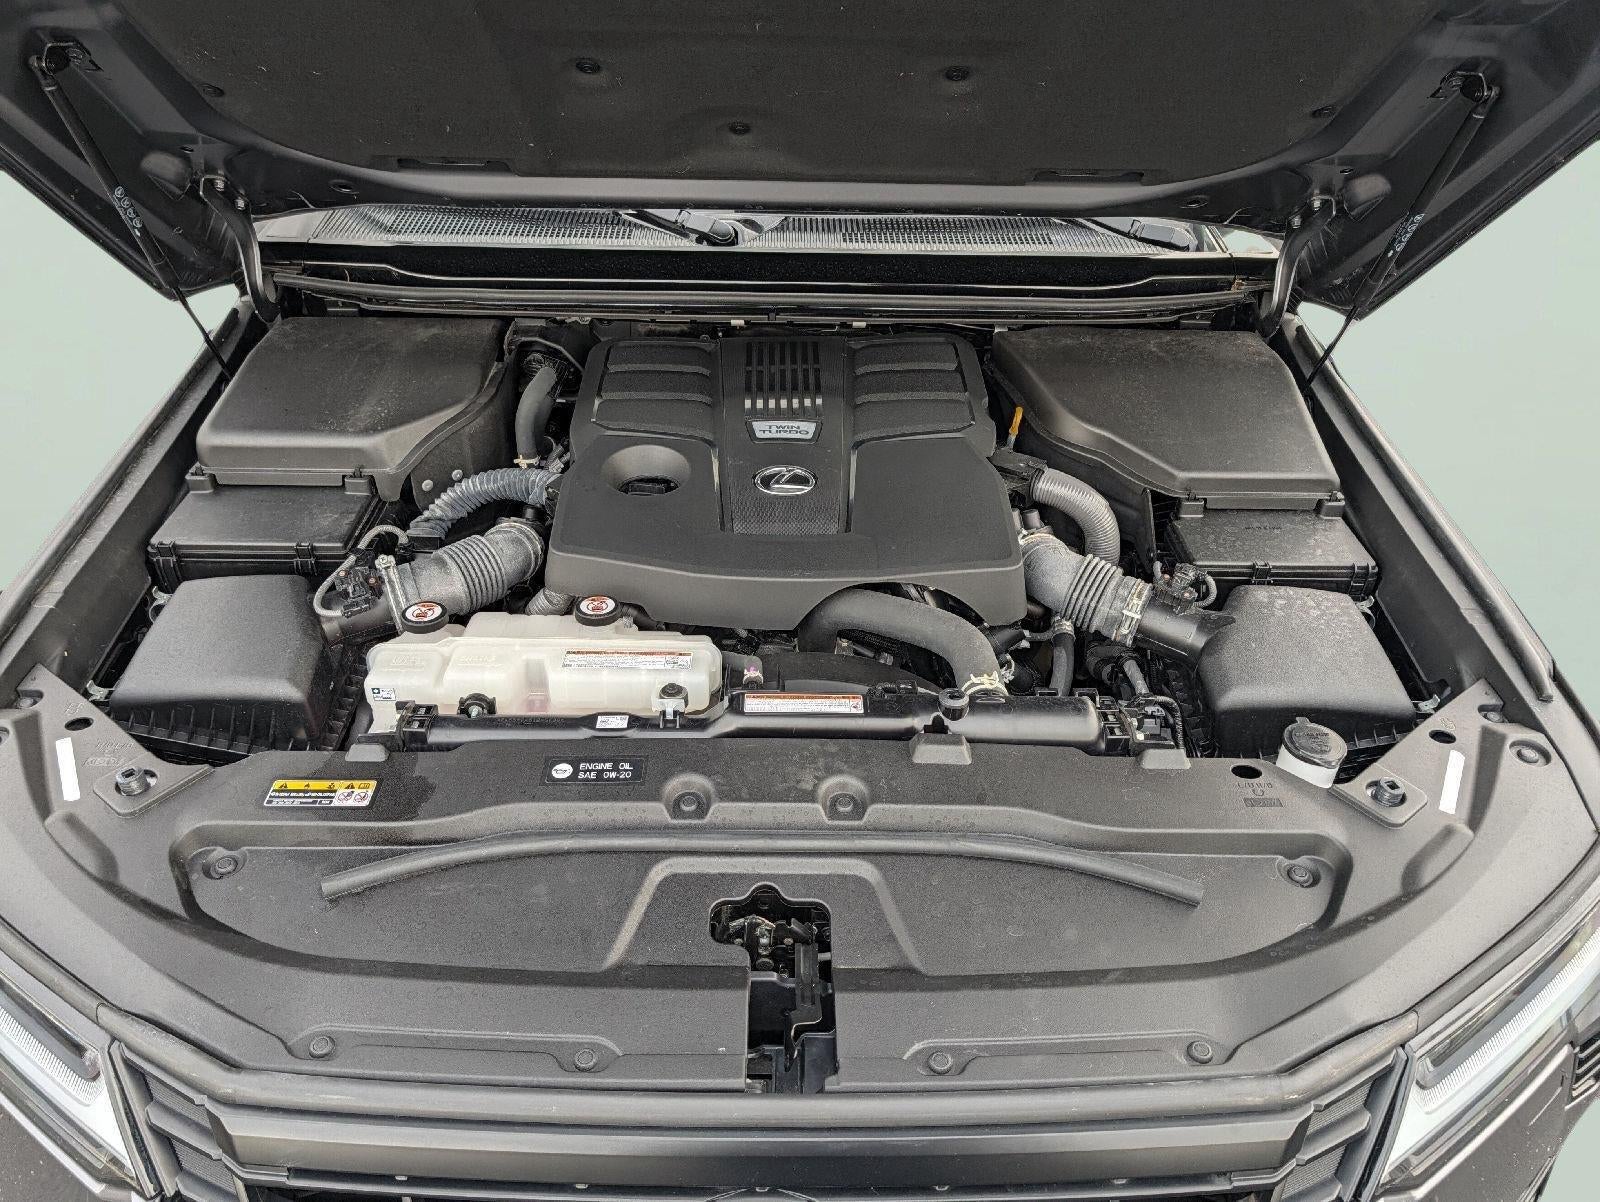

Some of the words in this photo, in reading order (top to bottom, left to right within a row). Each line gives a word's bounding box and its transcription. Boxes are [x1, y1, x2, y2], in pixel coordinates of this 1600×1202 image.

[579, 762, 614, 770] ENGINE
[618, 762, 634, 770] OIL
[578, 771, 598, 779] SAE
[603, 771, 632, 779] 0W-20
